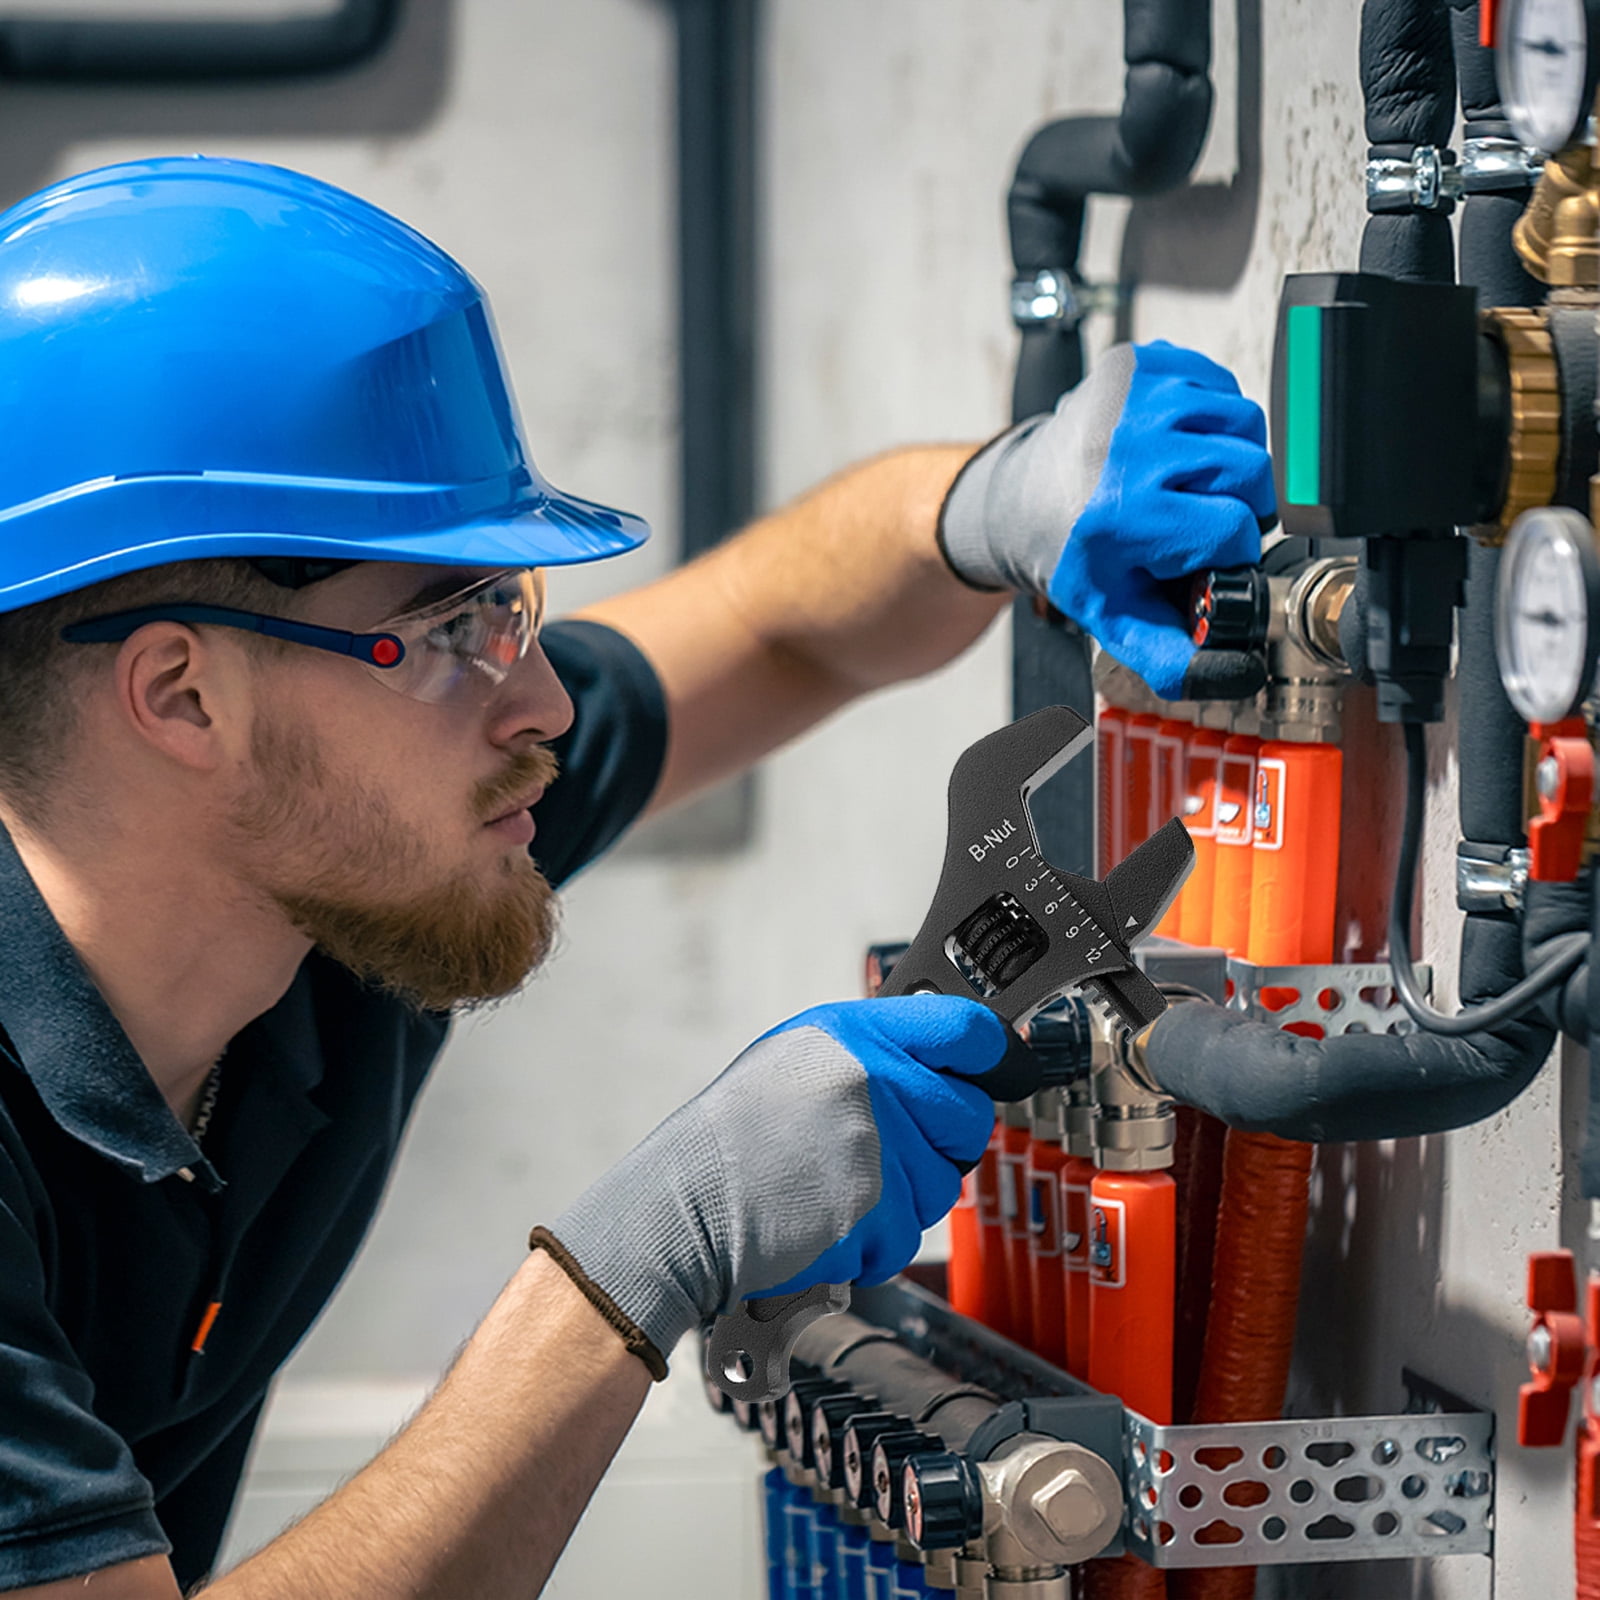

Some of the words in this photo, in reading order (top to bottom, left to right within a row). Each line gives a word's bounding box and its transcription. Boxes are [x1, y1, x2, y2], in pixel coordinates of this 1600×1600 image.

[968, 819, 1017, 862] B-Nut
[1006, 855, 1019, 869] 0
[1025, 878, 1039, 892] 3
[1045, 901, 1058, 915] 6
[1065, 926, 1079, 939] 9
[1085, 947, 1102, 964] 12
